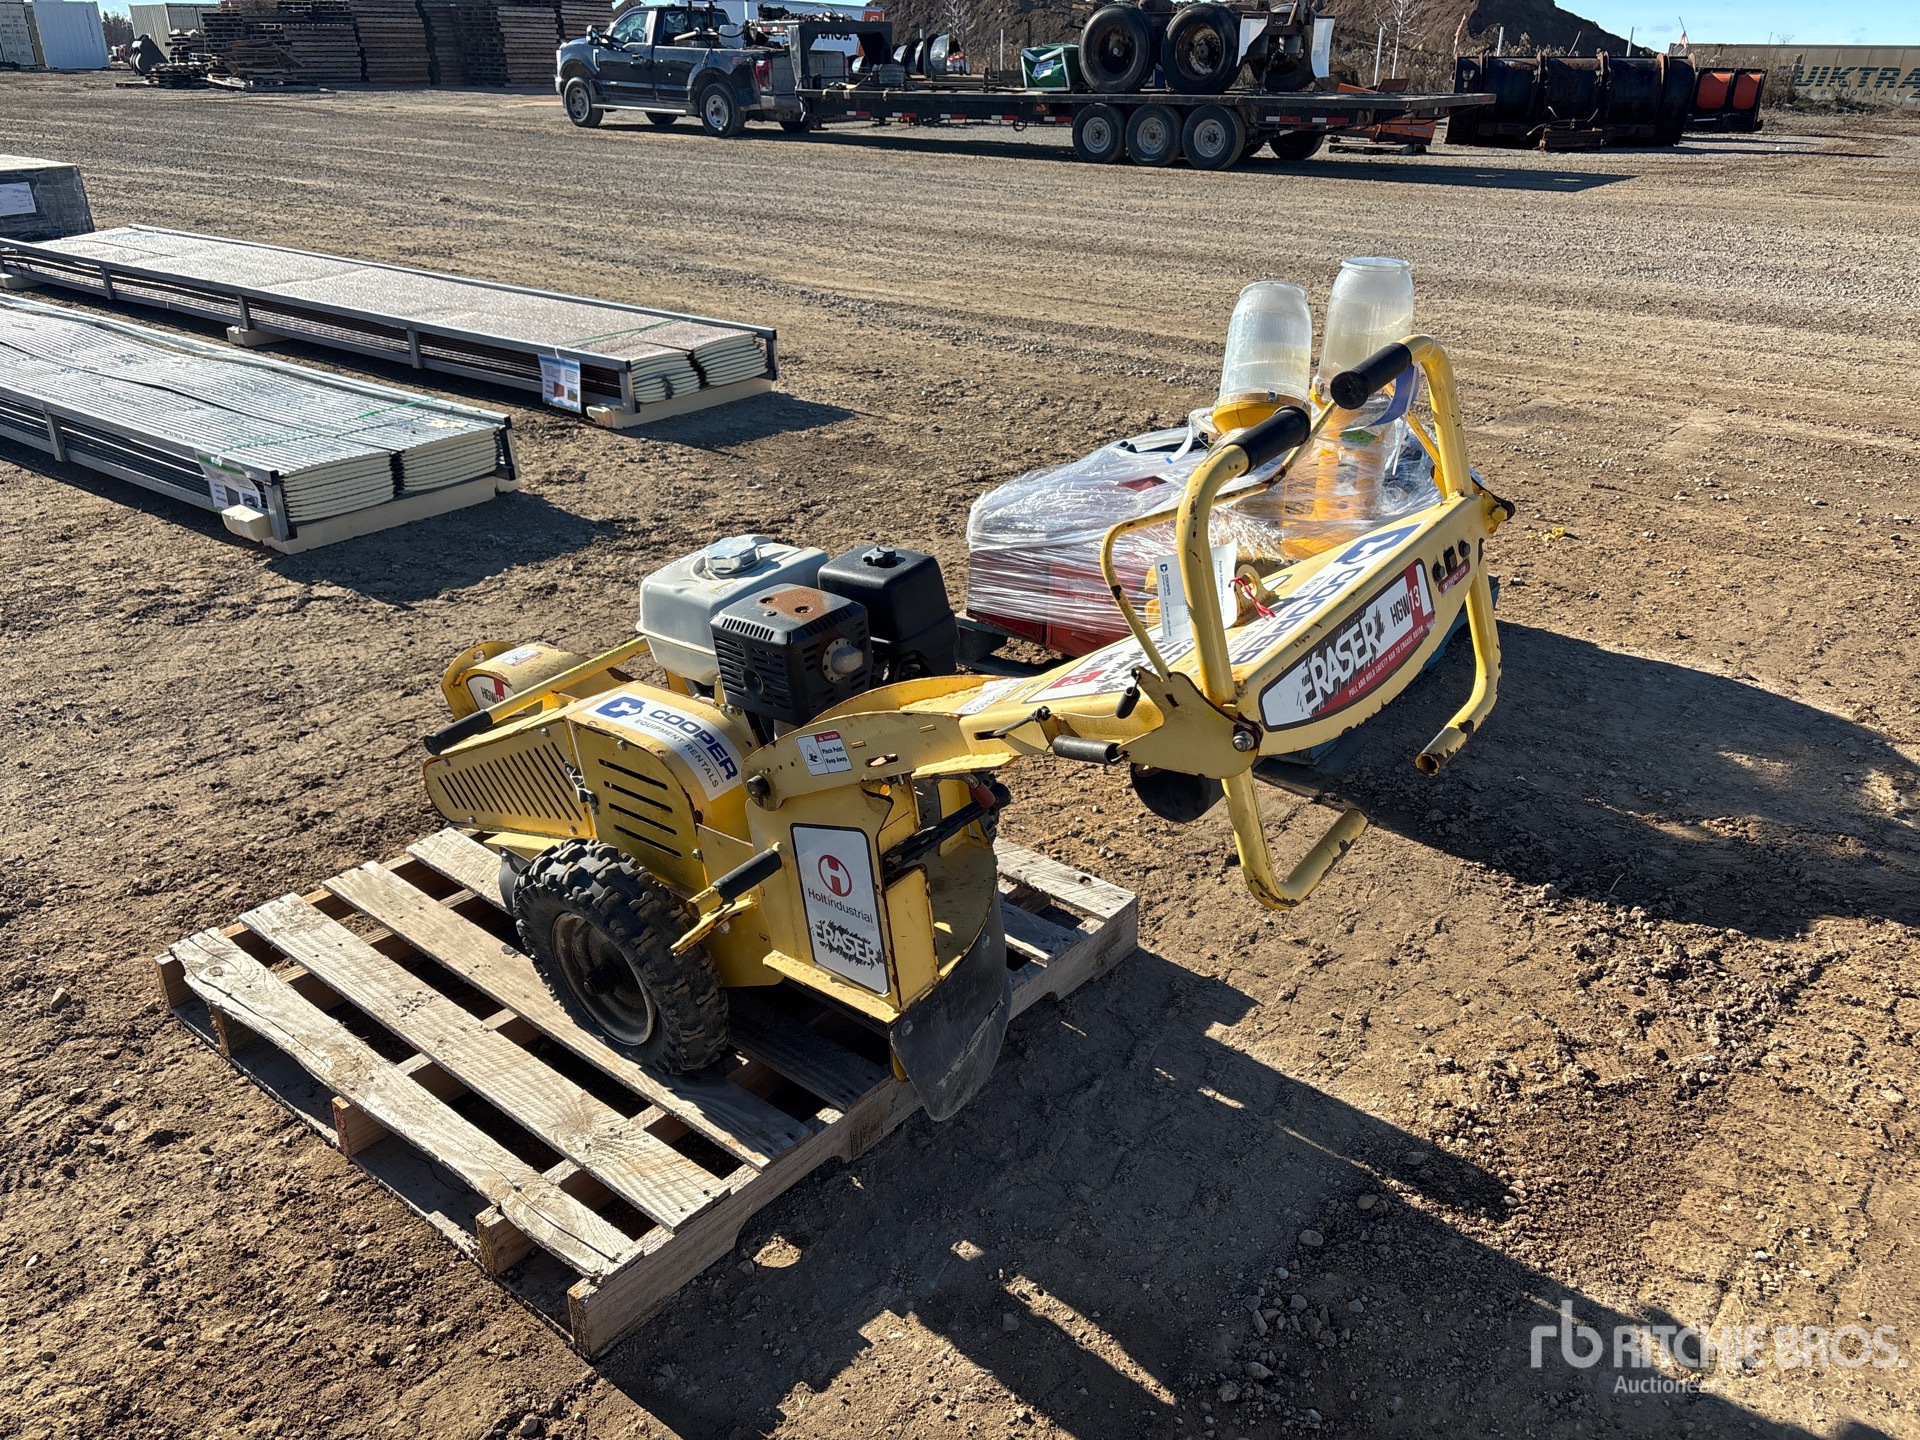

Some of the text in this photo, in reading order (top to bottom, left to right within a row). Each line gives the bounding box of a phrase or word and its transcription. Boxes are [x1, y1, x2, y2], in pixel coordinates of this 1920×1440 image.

[1780, 66, 1920, 88] UIKTRA
[1230, 566, 1366, 665] COOPER
[1389, 584, 1421, 628] HGW13
[1299, 614, 1383, 715] ERASER
[1348, 684, 1359, 698] PULL
[1357, 677, 1367, 690] AND
[1365, 668, 1376, 683] HOLD
[1374, 659, 1389, 674] SAFETY
[1388, 650, 1396, 662] BAR
[1394, 645, 1401, 656] TO
[1400, 634, 1414, 651] ENGAGE
[634, 719, 720, 788] EQUIPMENT RENTALS
[648, 709, 739, 781] COOPER
[807, 887, 873, 925] Holtindustrial
[813, 922, 878, 964] ERASER
